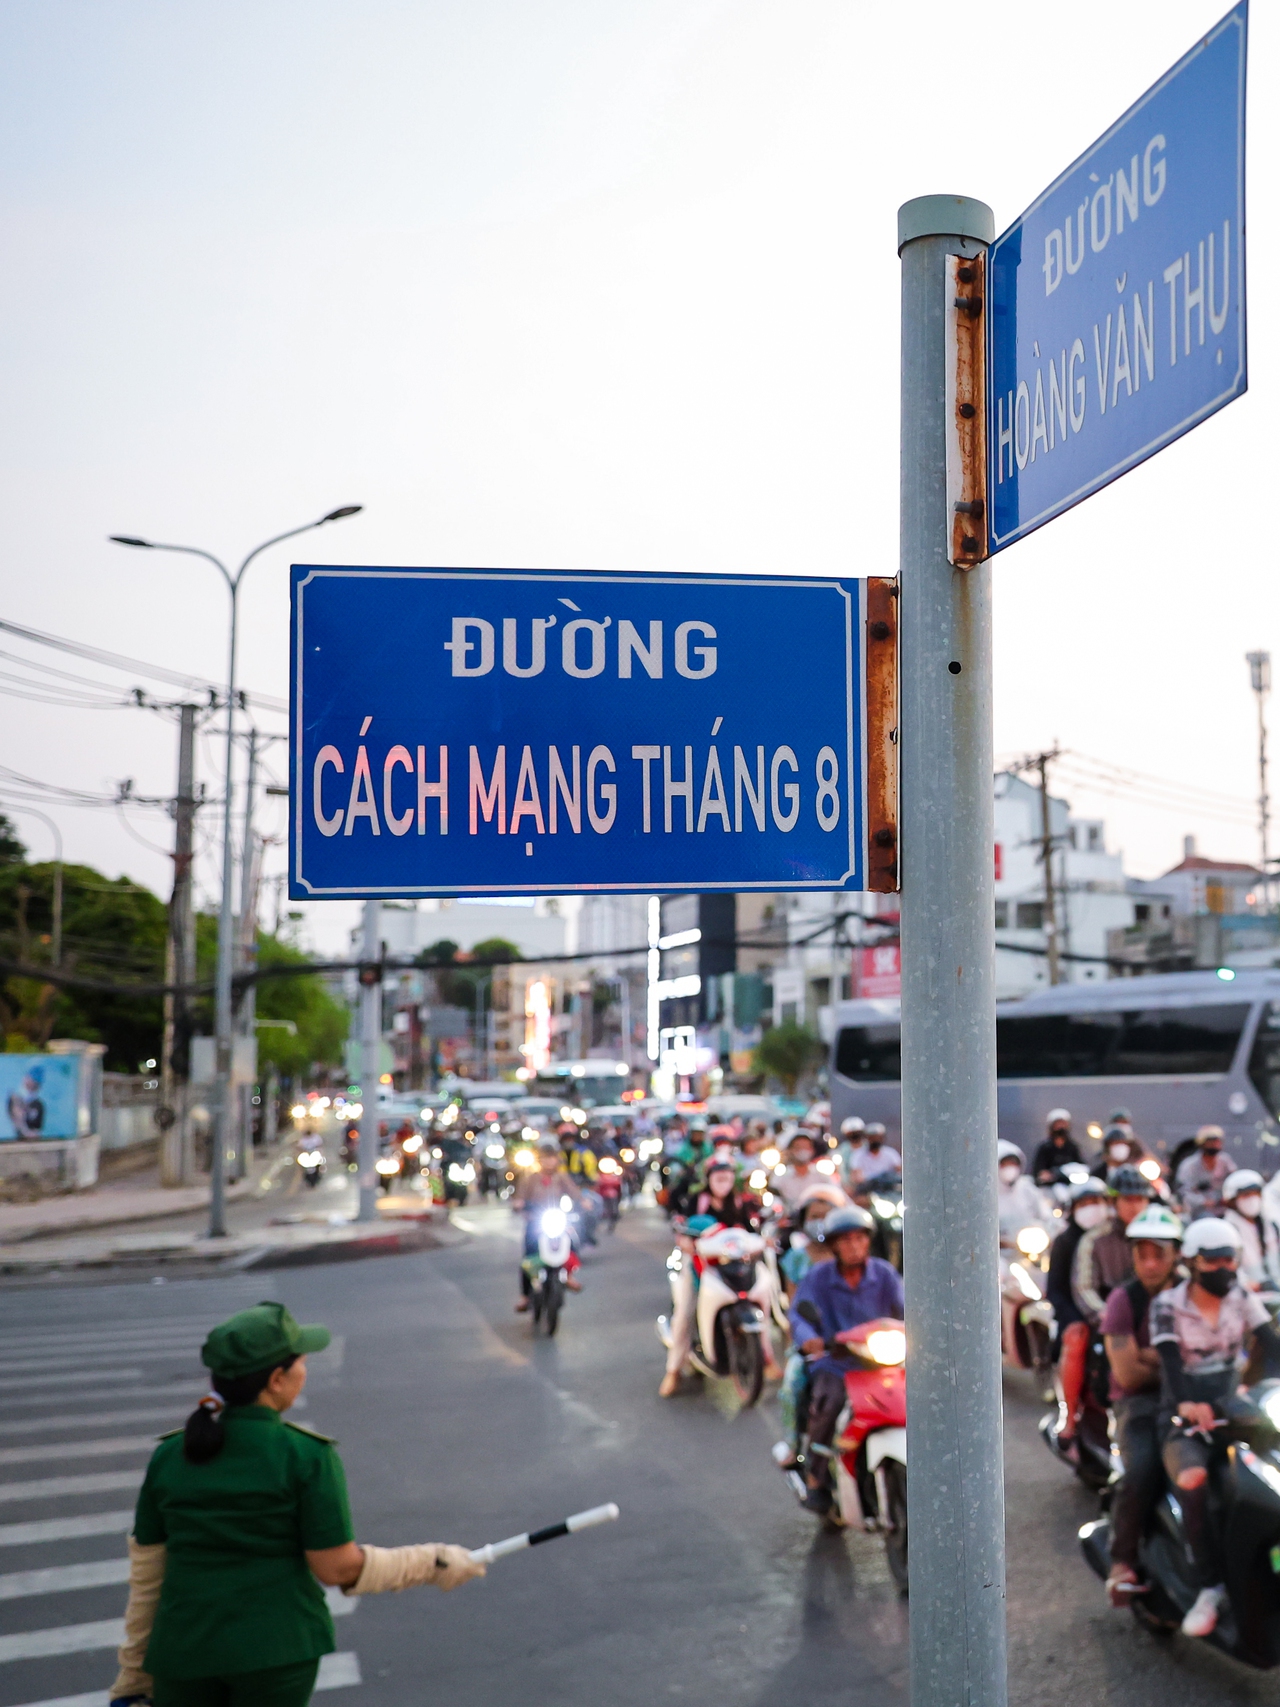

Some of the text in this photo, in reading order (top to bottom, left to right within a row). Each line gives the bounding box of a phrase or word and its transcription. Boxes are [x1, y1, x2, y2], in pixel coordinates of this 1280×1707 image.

[1042, 134, 1167, 297] ĐƯỜNG
[999, 219, 1231, 485] HOÀNG VĂN THỤ
[444, 598, 718, 679] ĐƯỜNG
[313, 716, 840, 857] CÁCH MẠNG THÁNG 8
